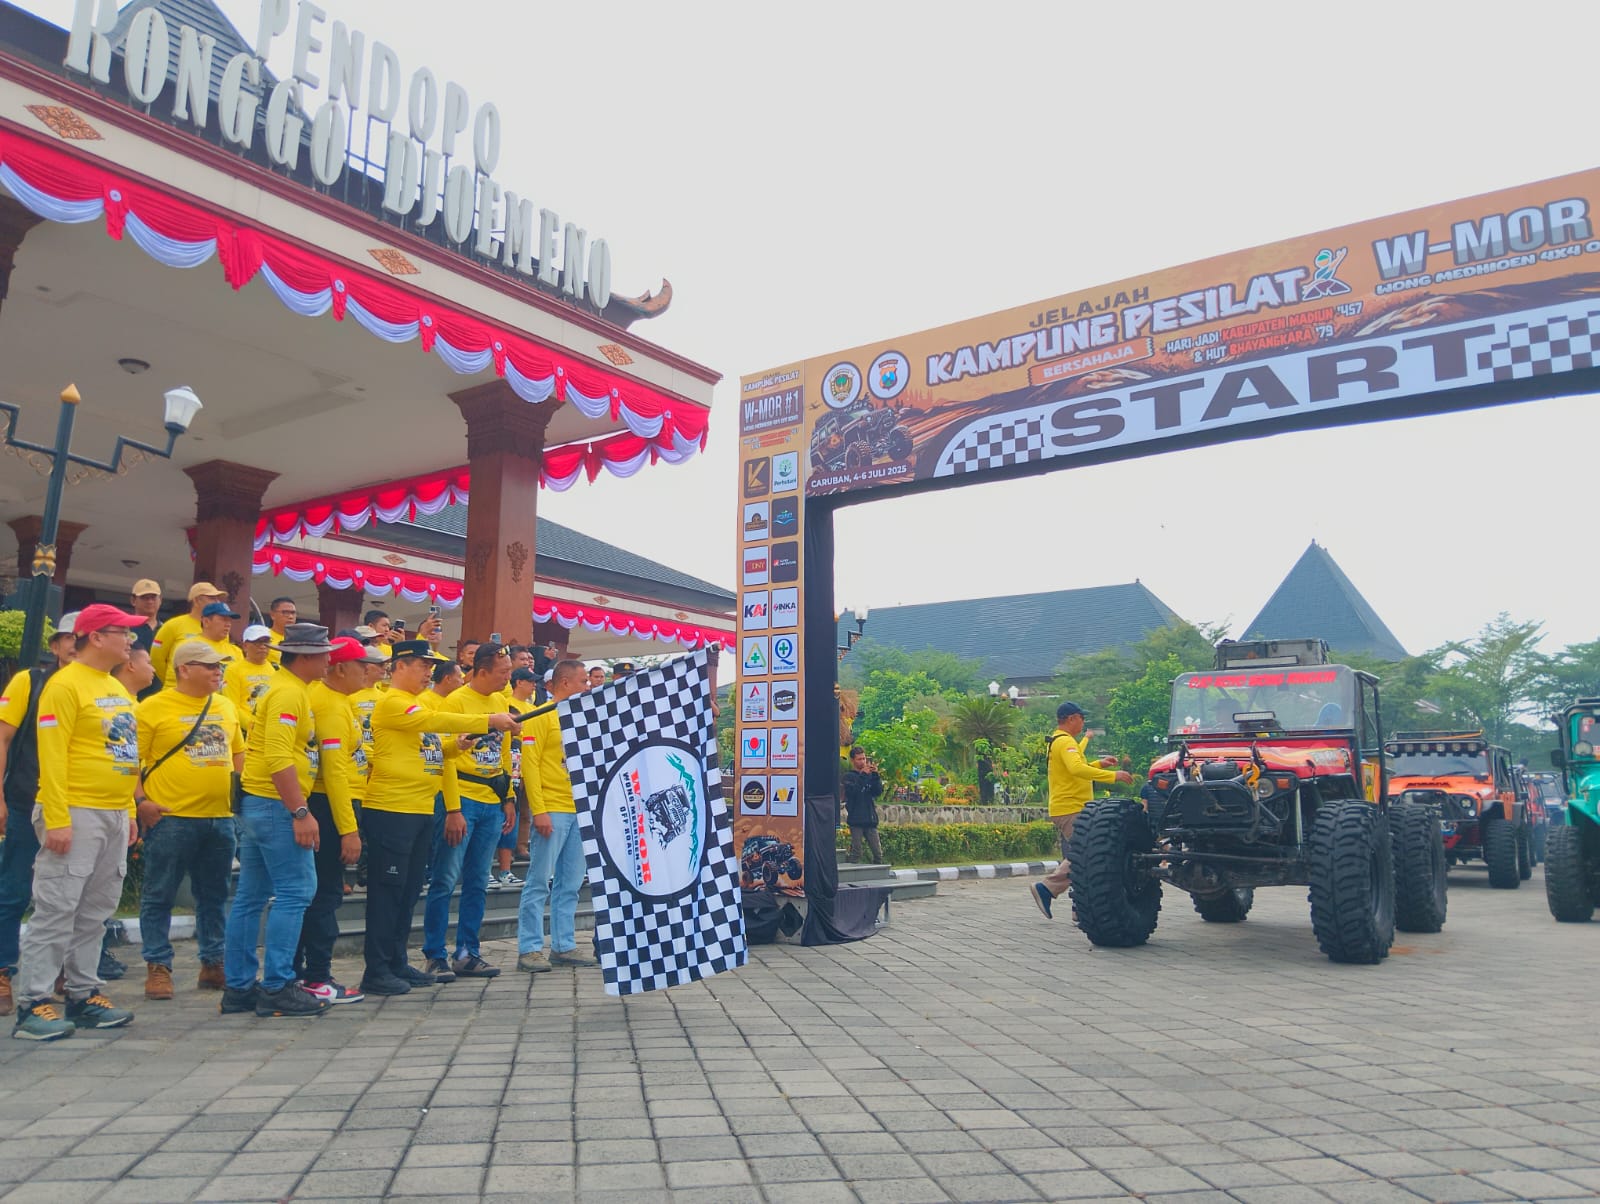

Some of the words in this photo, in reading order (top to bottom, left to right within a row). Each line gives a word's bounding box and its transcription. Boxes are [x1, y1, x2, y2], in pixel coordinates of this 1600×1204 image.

[257, 0, 500, 176] PENDOPO
[64, 0, 346, 186] RONGGO
[381, 131, 612, 310] DJOEMENO
[1372, 197, 1594, 280] W-MOR
[1376, 274, 1433, 295] WONG
[1435, 253, 1537, 284] MEDHIOEN
[1540, 244, 1581, 261] 4X4
[927, 312, 1117, 386] KAMPUNG
[1122, 265, 1310, 341] PESILAT
[1029, 286, 1150, 328] JELAJAH
[1166, 338, 1193, 353] HARI
[1195, 332, 1219, 347] JADI
[1222, 318, 1286, 342] KABUPATEN
[1289, 307, 1333, 327] MADIUN
[1043, 345, 1135, 379] BERSAHAJA
[1194, 350, 1203, 363] &
[1206, 345, 1227, 361] HUT
[1229, 328, 1312, 356] BHAYANGKARA
[744, 395, 782, 423] W-MOR
[785, 390, 799, 415] #1
[1050, 325, 1494, 448] START
[811, 474, 852, 488] CARUBAN,
[853, 471, 867, 481] 4-6
[868, 469, 886, 479] JULI
[887, 464, 907, 476] 2025
[622, 771, 636, 802] WONG
[619, 806, 629, 826] OFF
[624, 828, 633, 856] ROAD
[630, 768, 652, 883] W-MOR
